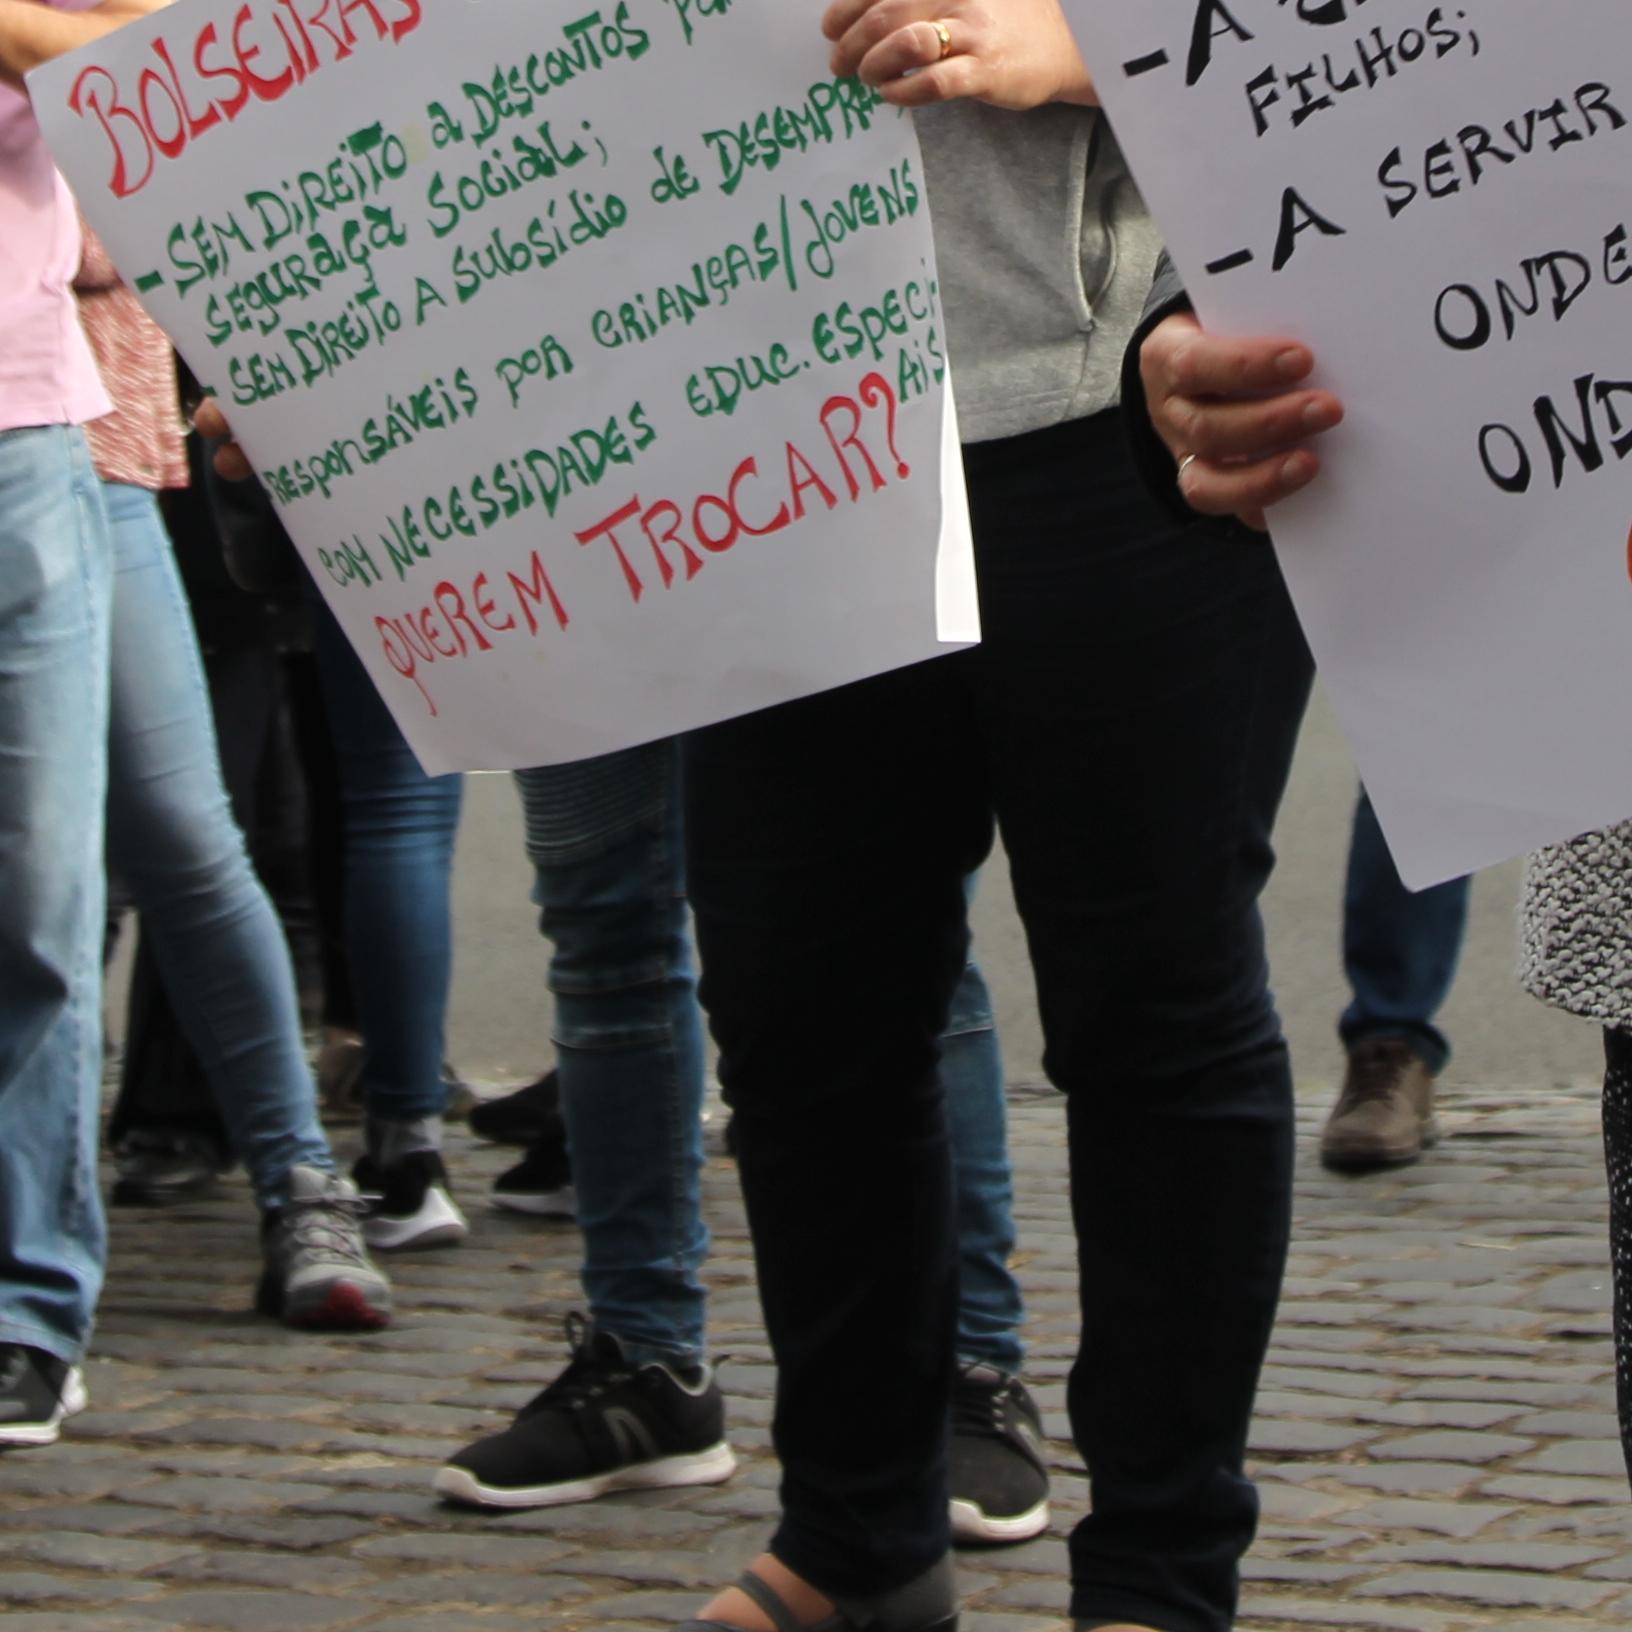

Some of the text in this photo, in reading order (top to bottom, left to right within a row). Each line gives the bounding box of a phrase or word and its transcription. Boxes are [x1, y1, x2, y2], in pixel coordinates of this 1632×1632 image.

[462, 1, 649, 149] DESCONTOS
[1245, 8, 1482, 138] FILHOS;
[1377, 81, 1628, 218] SERVIR
[415, 277, 448, 326] A
[686, 343, 810, 417] EDUC.
[374, 372, 910, 717] QUEREM TROCAR?
